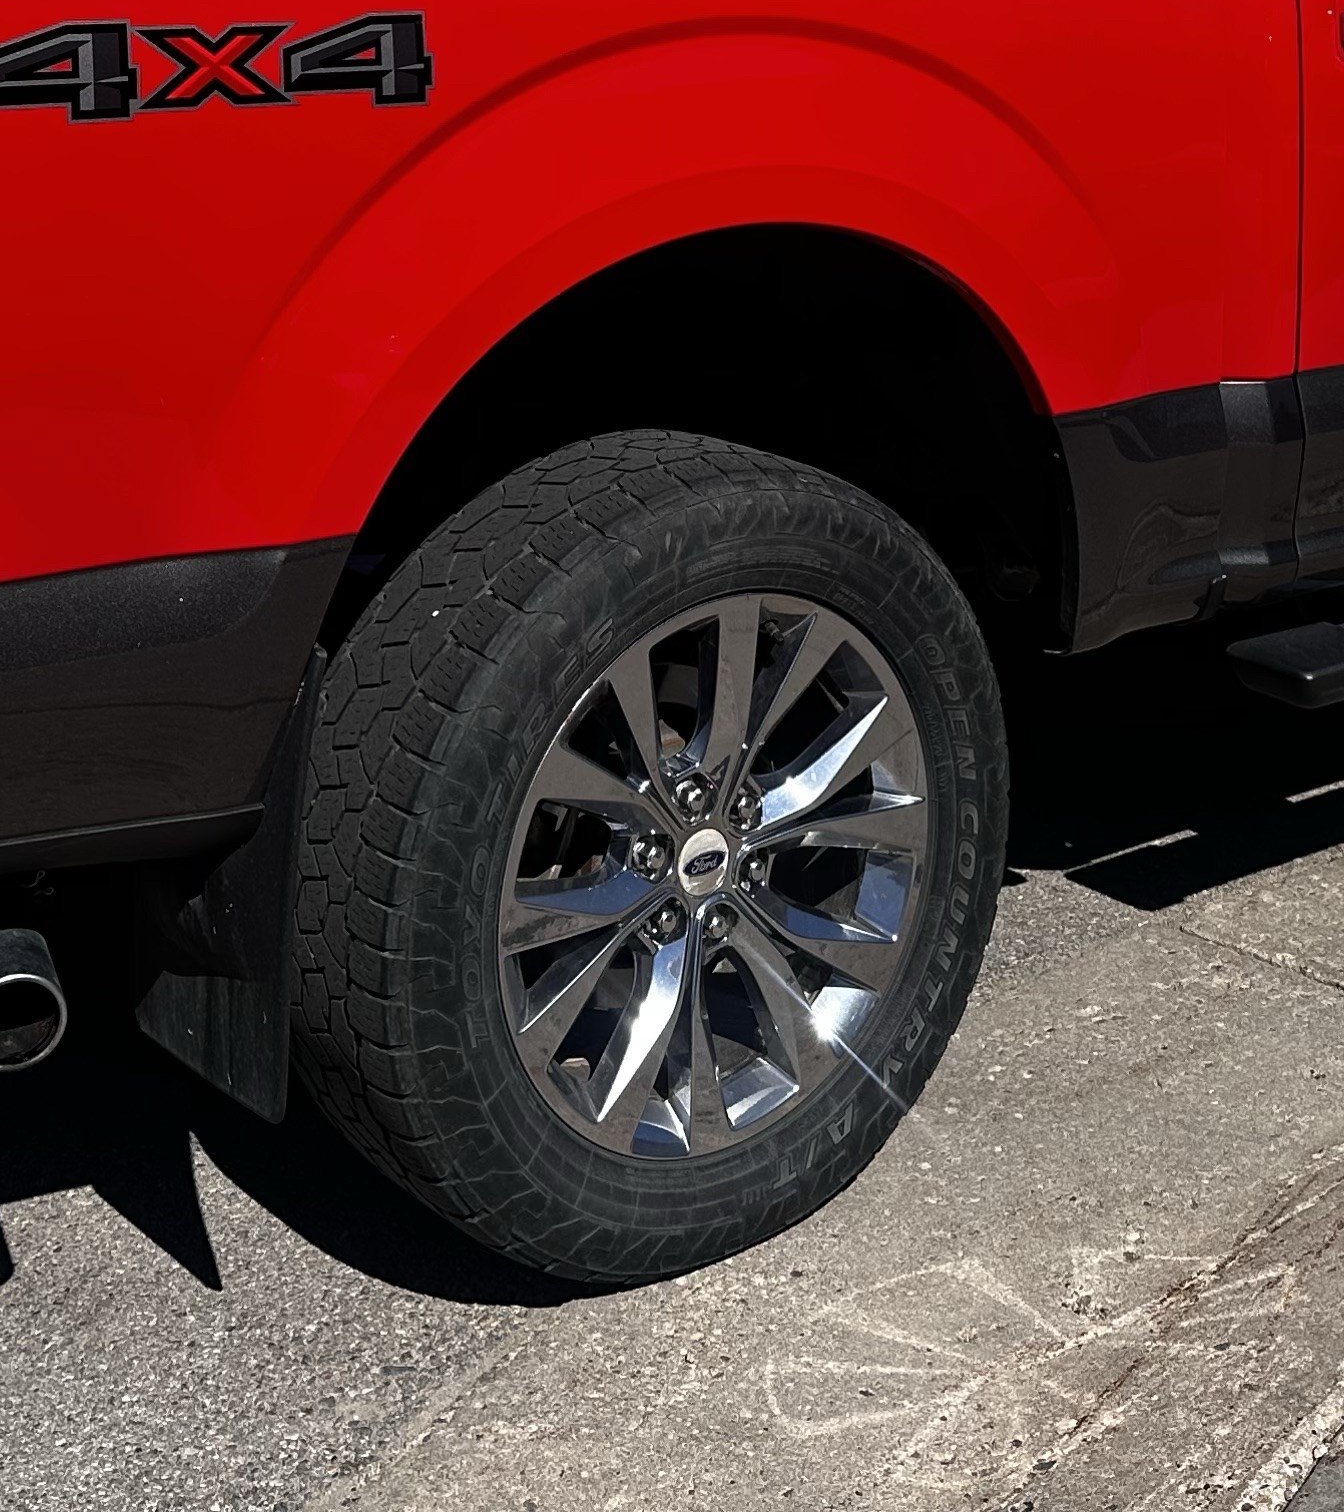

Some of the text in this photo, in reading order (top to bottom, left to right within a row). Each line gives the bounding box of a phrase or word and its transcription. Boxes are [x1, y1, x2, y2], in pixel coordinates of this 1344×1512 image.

[916, 632, 978, 782] OPEN
[460, 618, 615, 1049] TOYO TIRES
[691, 854, 718, 874] Ford
[879, 801, 980, 1088] COUNTRY
